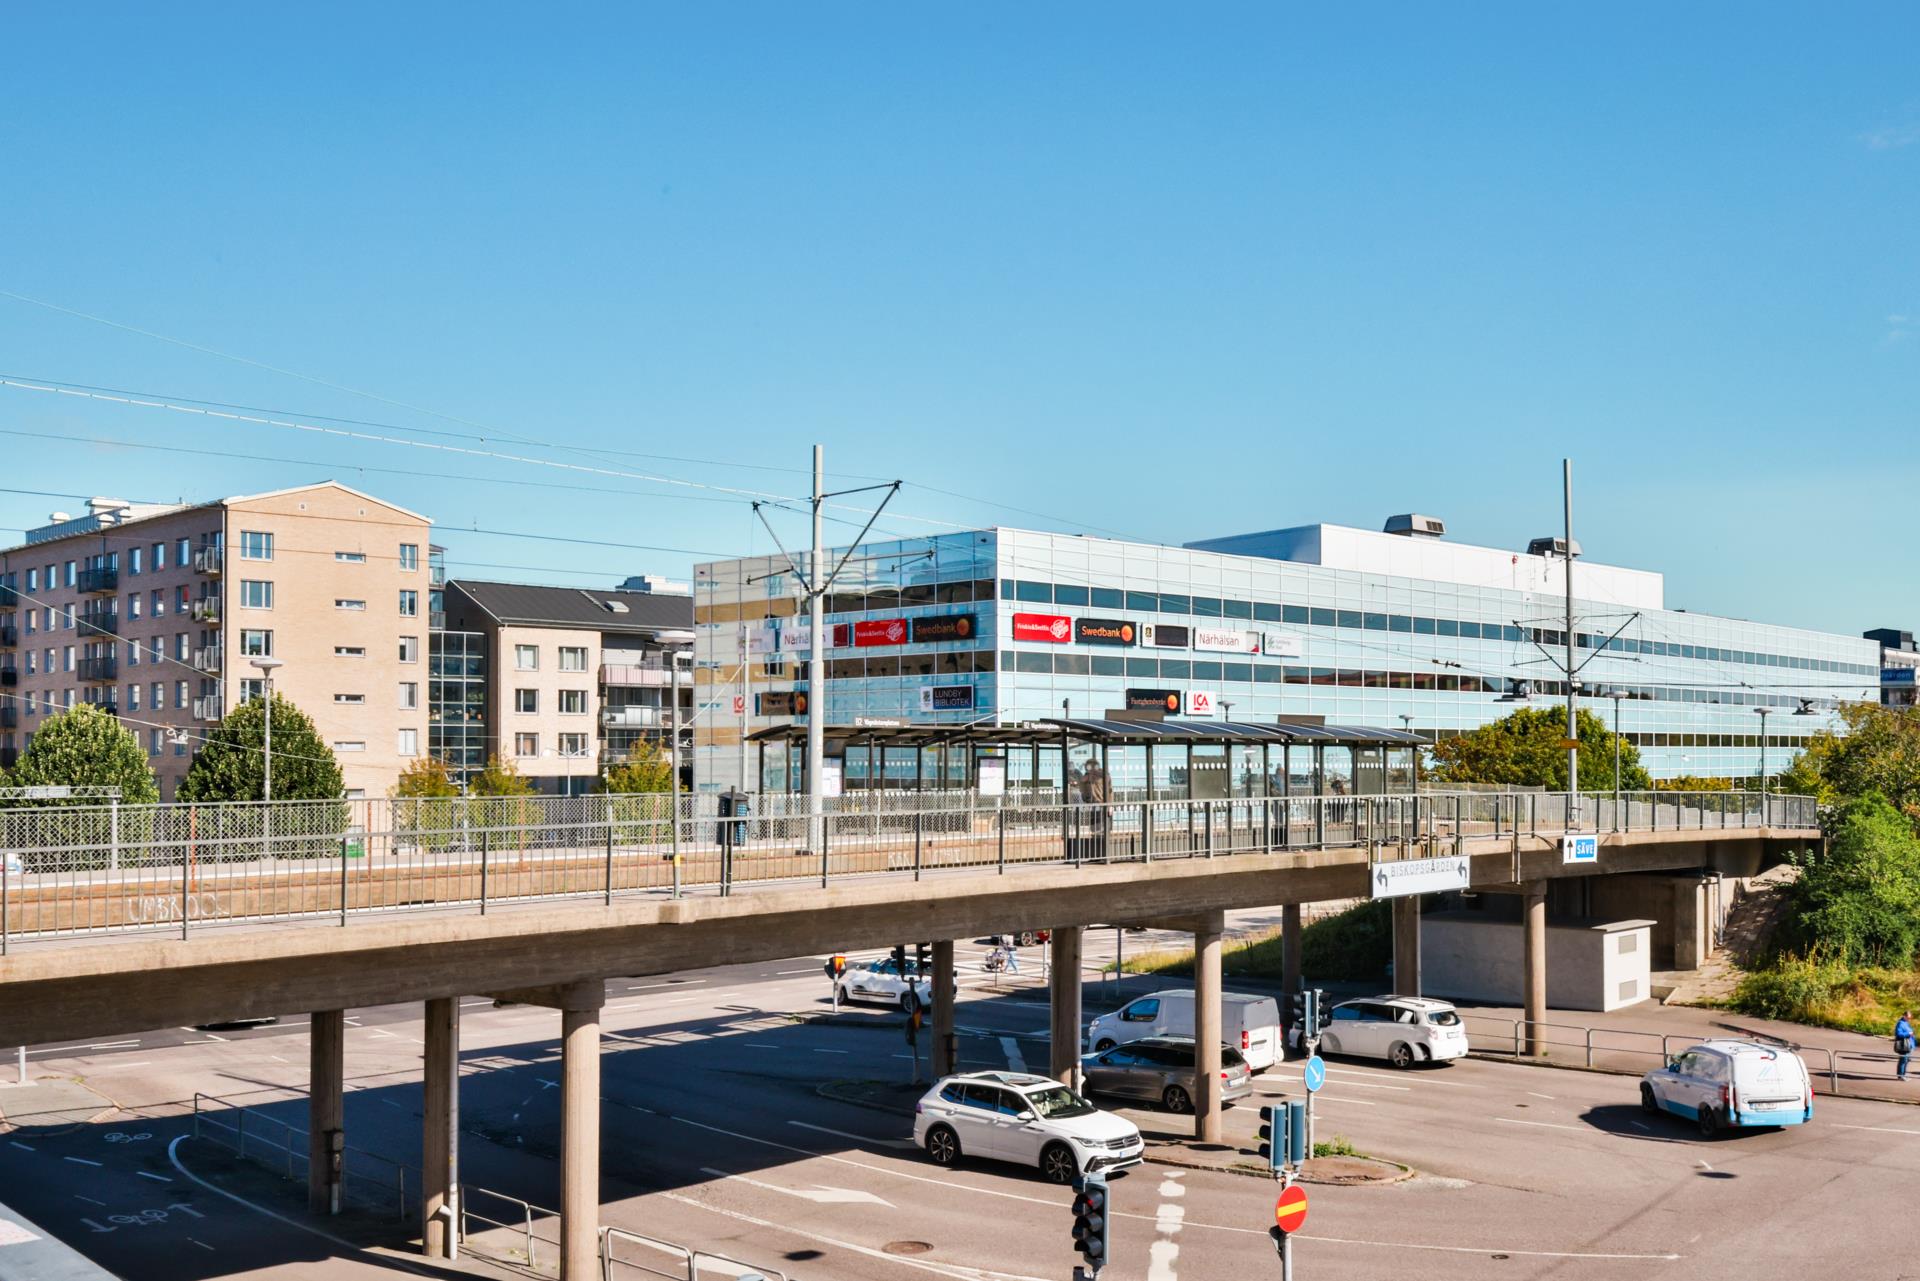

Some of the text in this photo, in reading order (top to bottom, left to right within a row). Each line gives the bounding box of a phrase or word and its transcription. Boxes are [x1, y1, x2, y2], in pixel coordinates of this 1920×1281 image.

[916, 623, 956, 635] Swedbank
[1081, 625, 1121, 637] Swedbank
[1199, 633, 1240, 646] Närhälsan
[935, 689, 962, 698] LUNDBY
[1193, 693, 1209, 706] ICA
[733, 696, 744, 709] IC
[935, 698, 970, 706] BIBLIOTEK
[1576, 841, 1594, 855] SÄVE
[1390, 859, 1456, 877] BISKOPSGÅRDEN
